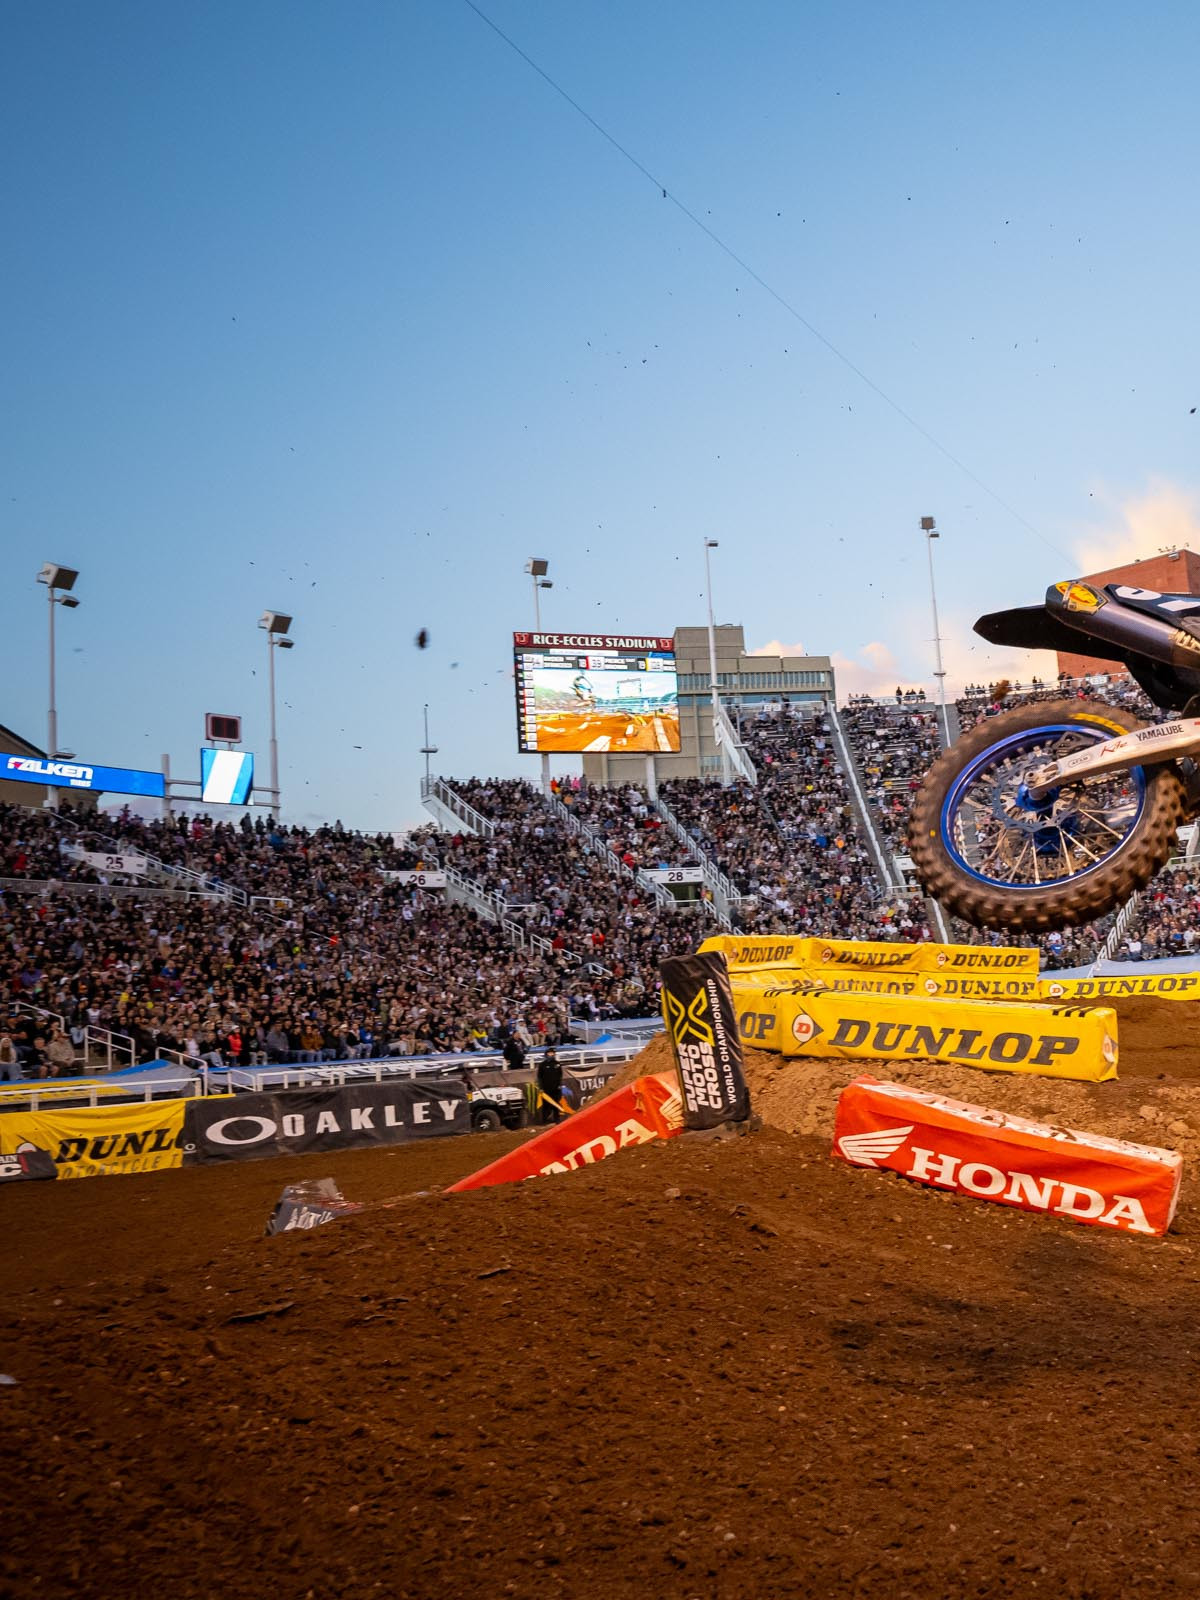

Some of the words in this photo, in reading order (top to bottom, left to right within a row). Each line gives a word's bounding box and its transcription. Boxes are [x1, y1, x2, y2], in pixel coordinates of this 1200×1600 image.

[533, 634, 603, 647] RICE-ECCLES
[606, 638, 657, 649] STADIUM
[1135, 725, 1184, 742] YAMALUBE
[7, 757, 94, 779] FALKEN
[106, 856, 124, 869] 25
[409, 875, 426, 886] 26
[668, 872, 684, 881] 28
[739, 945, 794, 963] DUNLOP
[835, 951, 912, 966] DUNLOP
[952, 953, 1030, 967] DUNLOP
[944, 979, 1034, 995] DUNLOP
[1074, 977, 1197, 995] DUNLOP
[706, 978, 730, 1062] CHAMPIONSHIP
[828, 1019, 1079, 1065] DUNLOP
[580, 1077, 605, 1091] UTAH
[679, 1042, 699, 1112] SUPER
[687, 1044, 709, 1106] MOTO
[699, 1042, 723, 1109] CROSS
[723, 1064, 737, 1104] WORLD
[281, 1100, 460, 1137] OAKLEY
[55, 1128, 184, 1163] DUNL
[522, 1119, 658, 1180] NDA
[61, 1154, 160, 1180] OTORCYCLE
[906, 1146, 1156, 1234] HONDA
